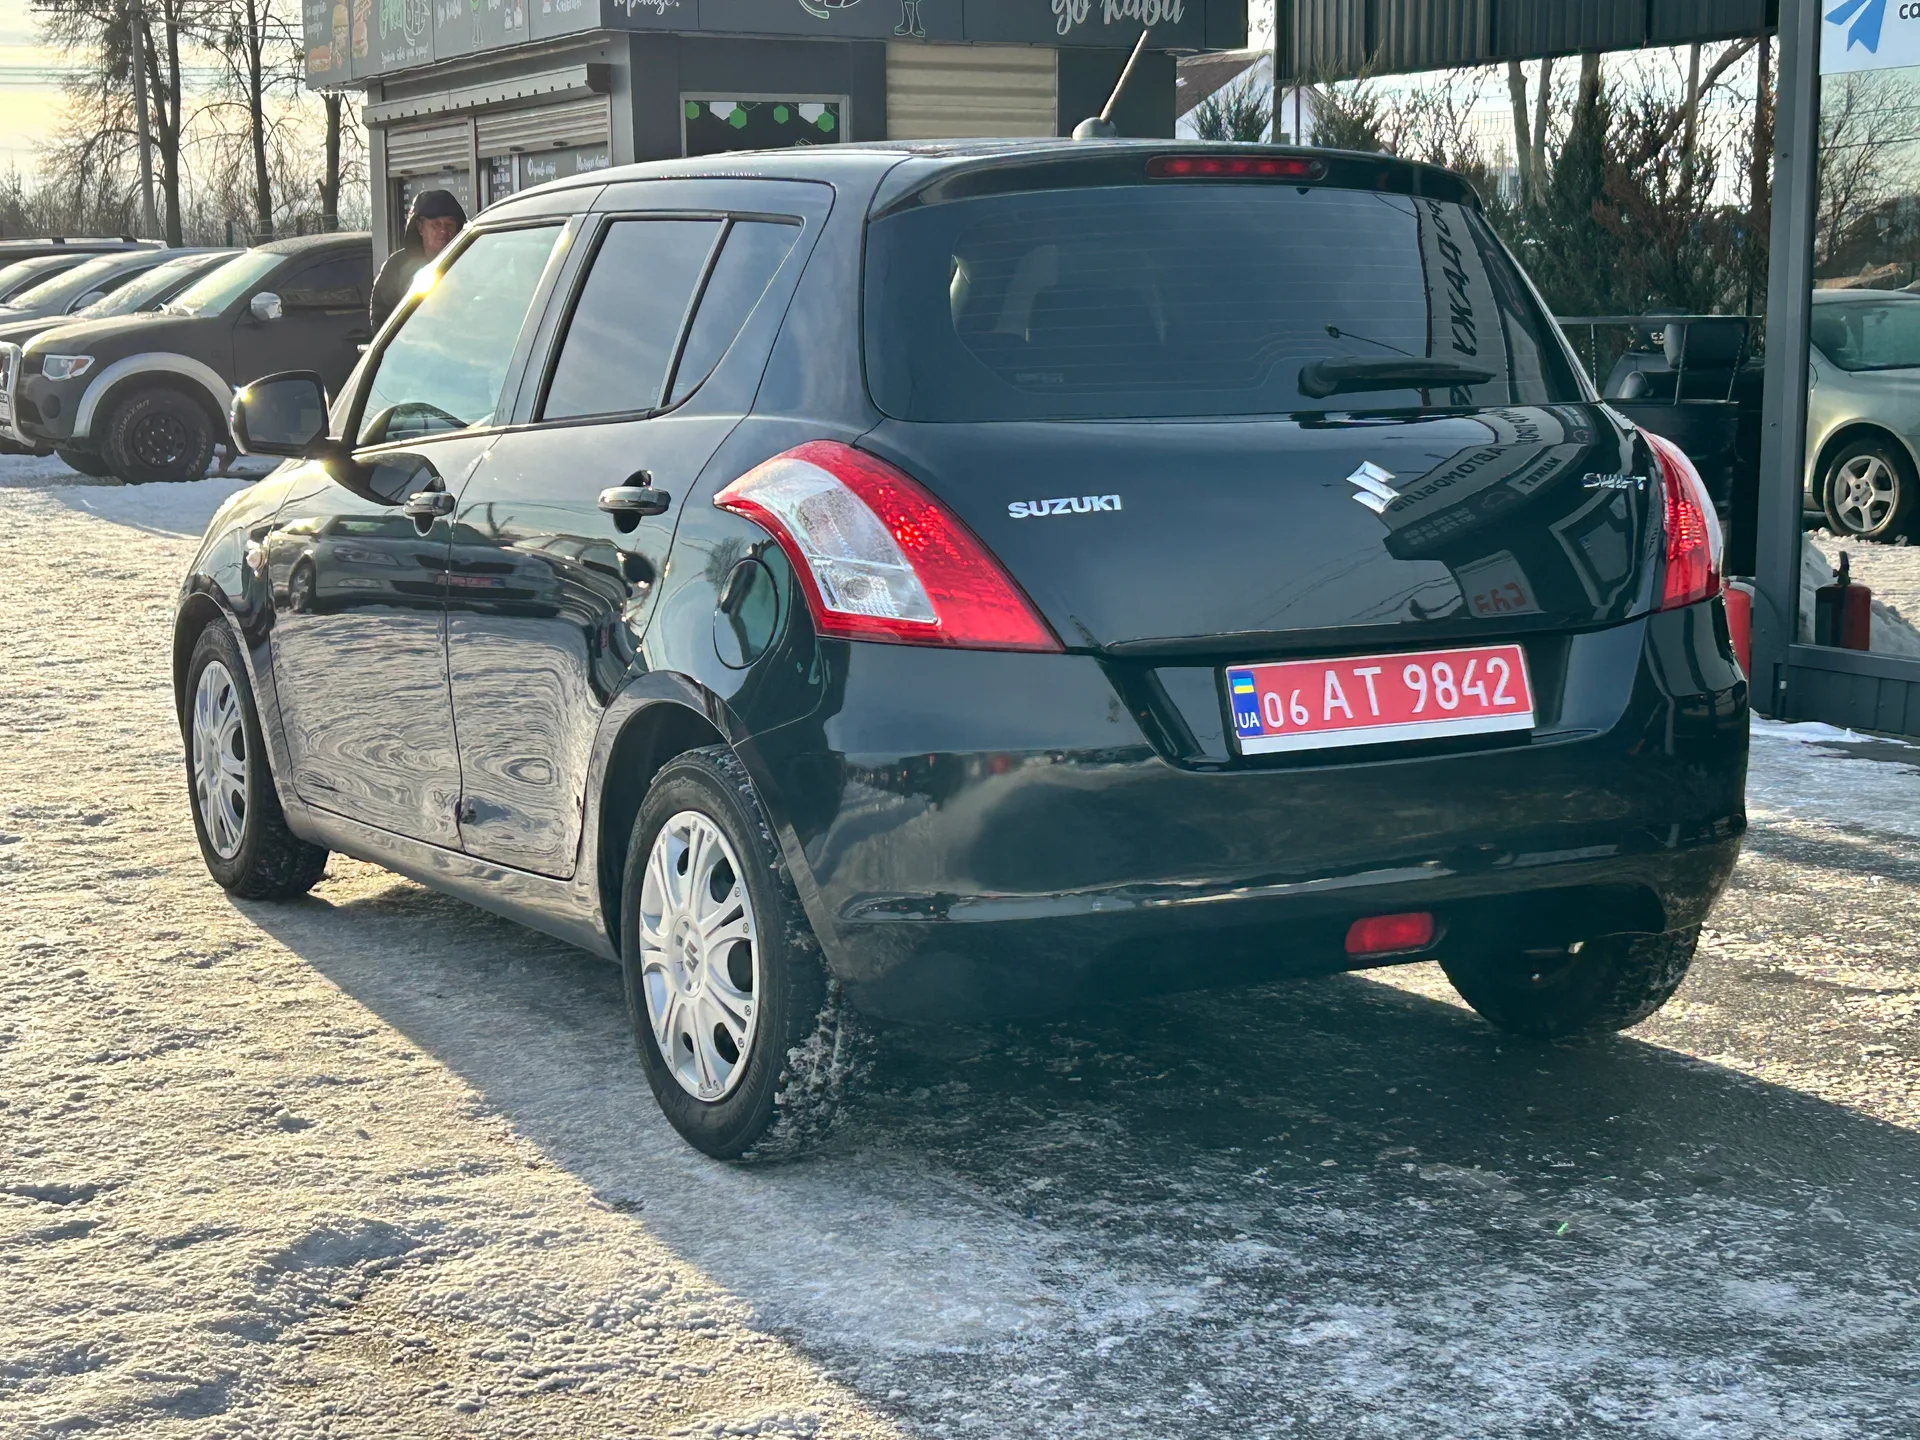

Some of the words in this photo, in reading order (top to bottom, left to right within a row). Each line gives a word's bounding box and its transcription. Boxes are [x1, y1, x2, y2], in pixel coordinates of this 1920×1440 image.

[1583, 472, 1647, 490] SWIFT
[1008, 494, 1122, 519] SUZUKI
[1263, 689, 1309, 728] 06
[1323, 666, 1382, 721] AT
[1402, 656, 1517, 714] 9842
[1238, 712, 1260, 729] UA
